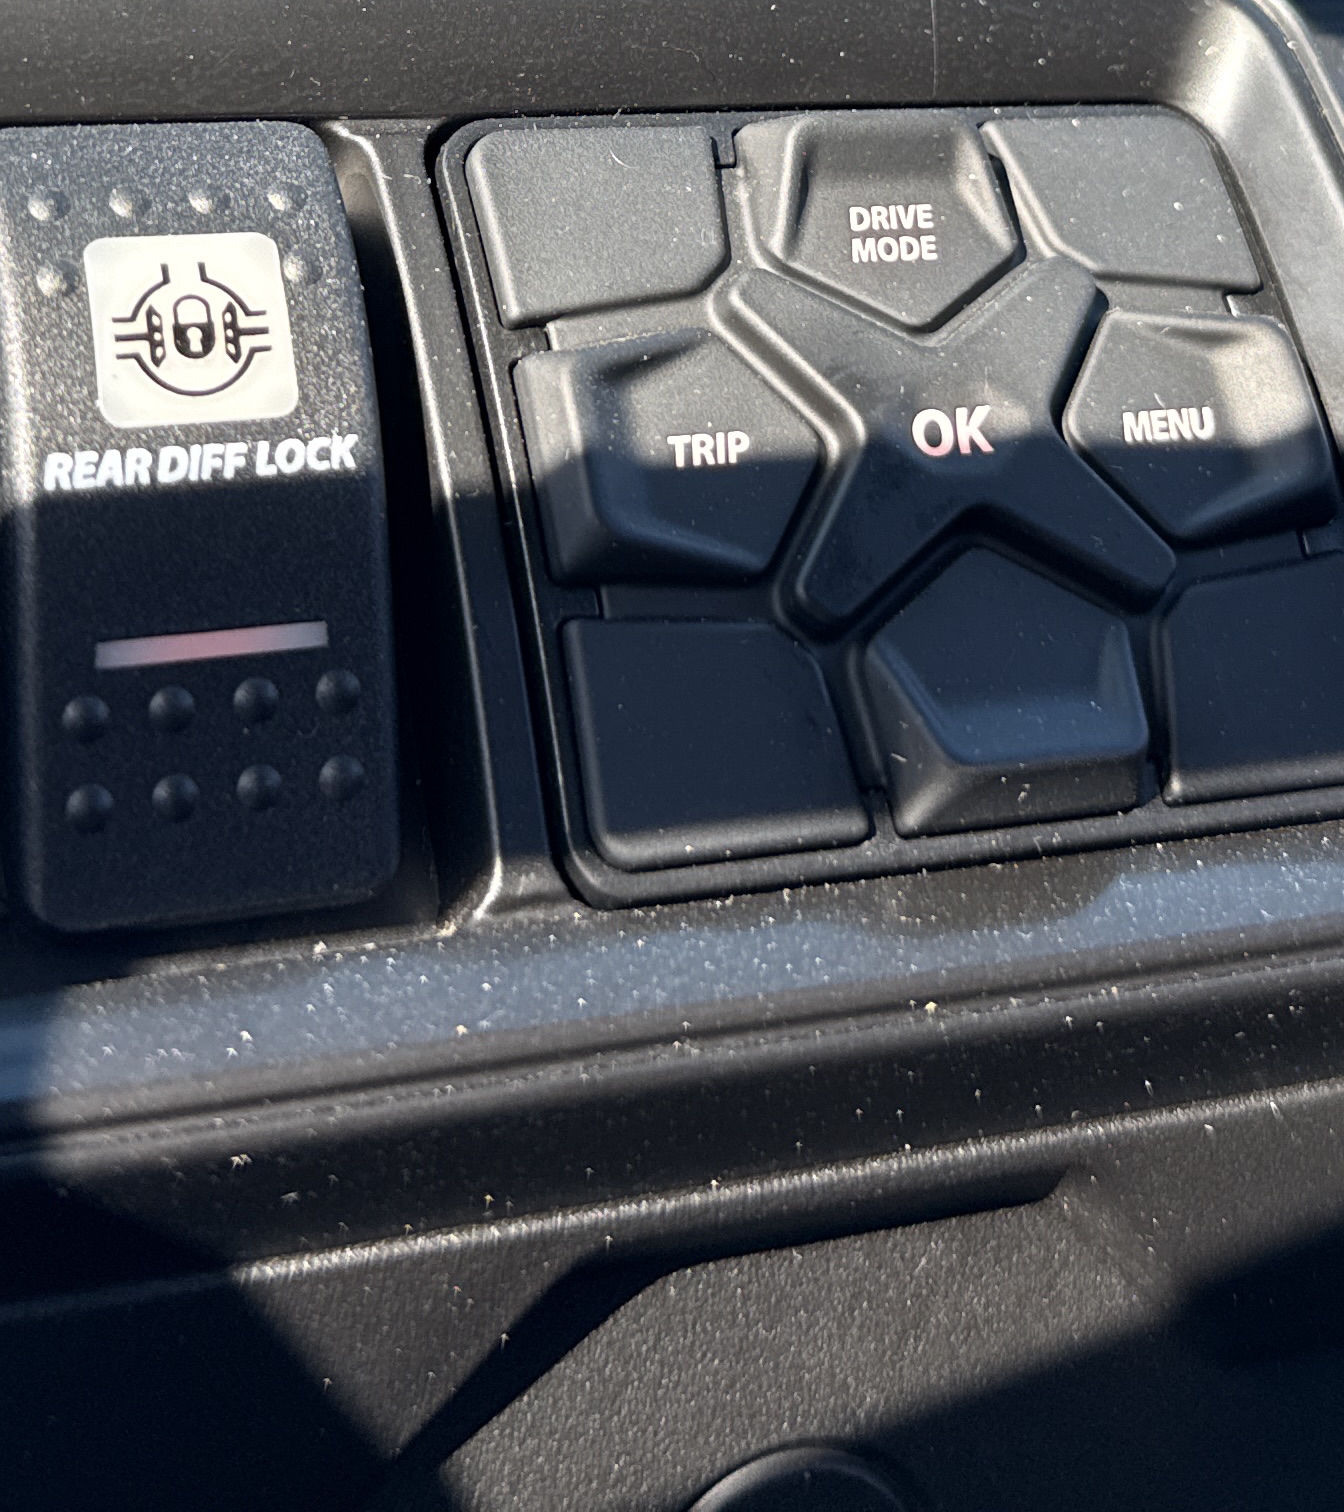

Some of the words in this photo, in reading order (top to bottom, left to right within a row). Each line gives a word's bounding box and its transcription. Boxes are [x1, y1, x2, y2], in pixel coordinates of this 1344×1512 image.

[849, 204, 934, 233] DRIVE
[851, 235, 938, 263] MODE
[912, 405, 994, 455] OK
[1123, 408, 1214, 442] MENU
[44, 449, 154, 491] REAR
[157, 442, 252, 483] DIFF
[256, 434, 358, 477] LOCK
[668, 432, 749, 466] TRIP
